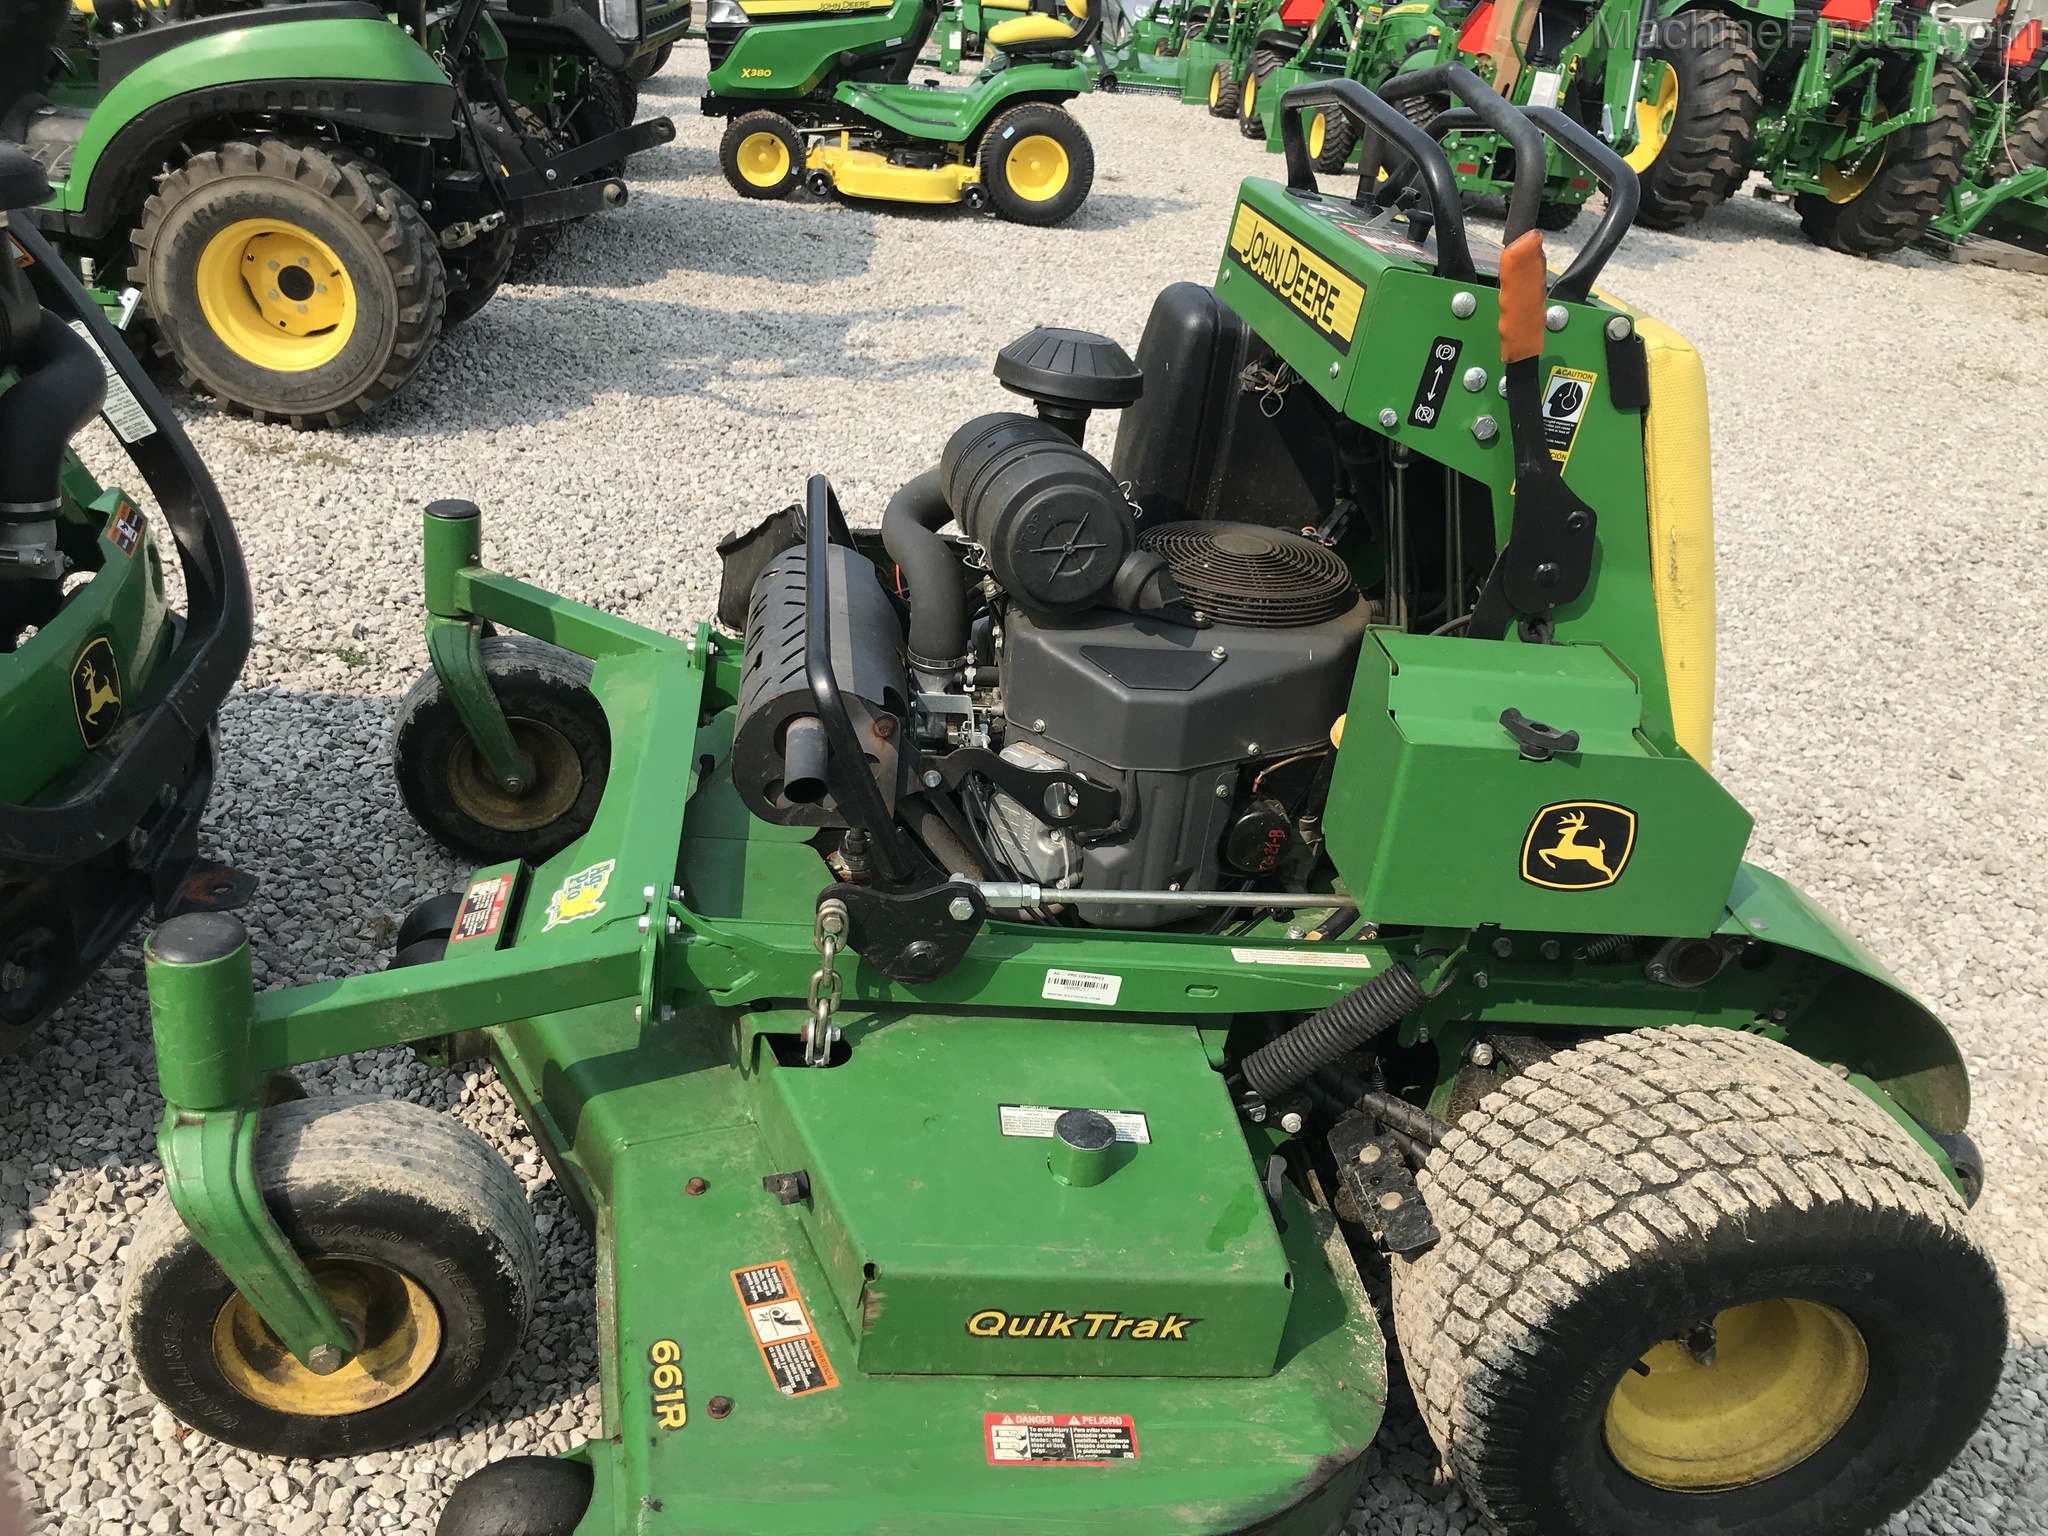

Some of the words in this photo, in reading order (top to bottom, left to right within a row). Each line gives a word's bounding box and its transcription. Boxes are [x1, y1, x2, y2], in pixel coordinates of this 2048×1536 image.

[818, 2, 842, 11] JOHN
[741, 68, 772, 78] X380
[1242, 220, 1285, 282] JOHN
[1281, 245, 1341, 326] DEERE
[1562, 369, 1593, 381] CAUTION
[435, 1257, 487, 1388] RELIANCE
[814, 1344, 835, 1381] ADVERTENCIA
[650, 1339, 688, 1430] 661R
[1015, 1415, 1055, 1424] DANGER
[1082, 1416, 1123, 1425] PELIGRO
